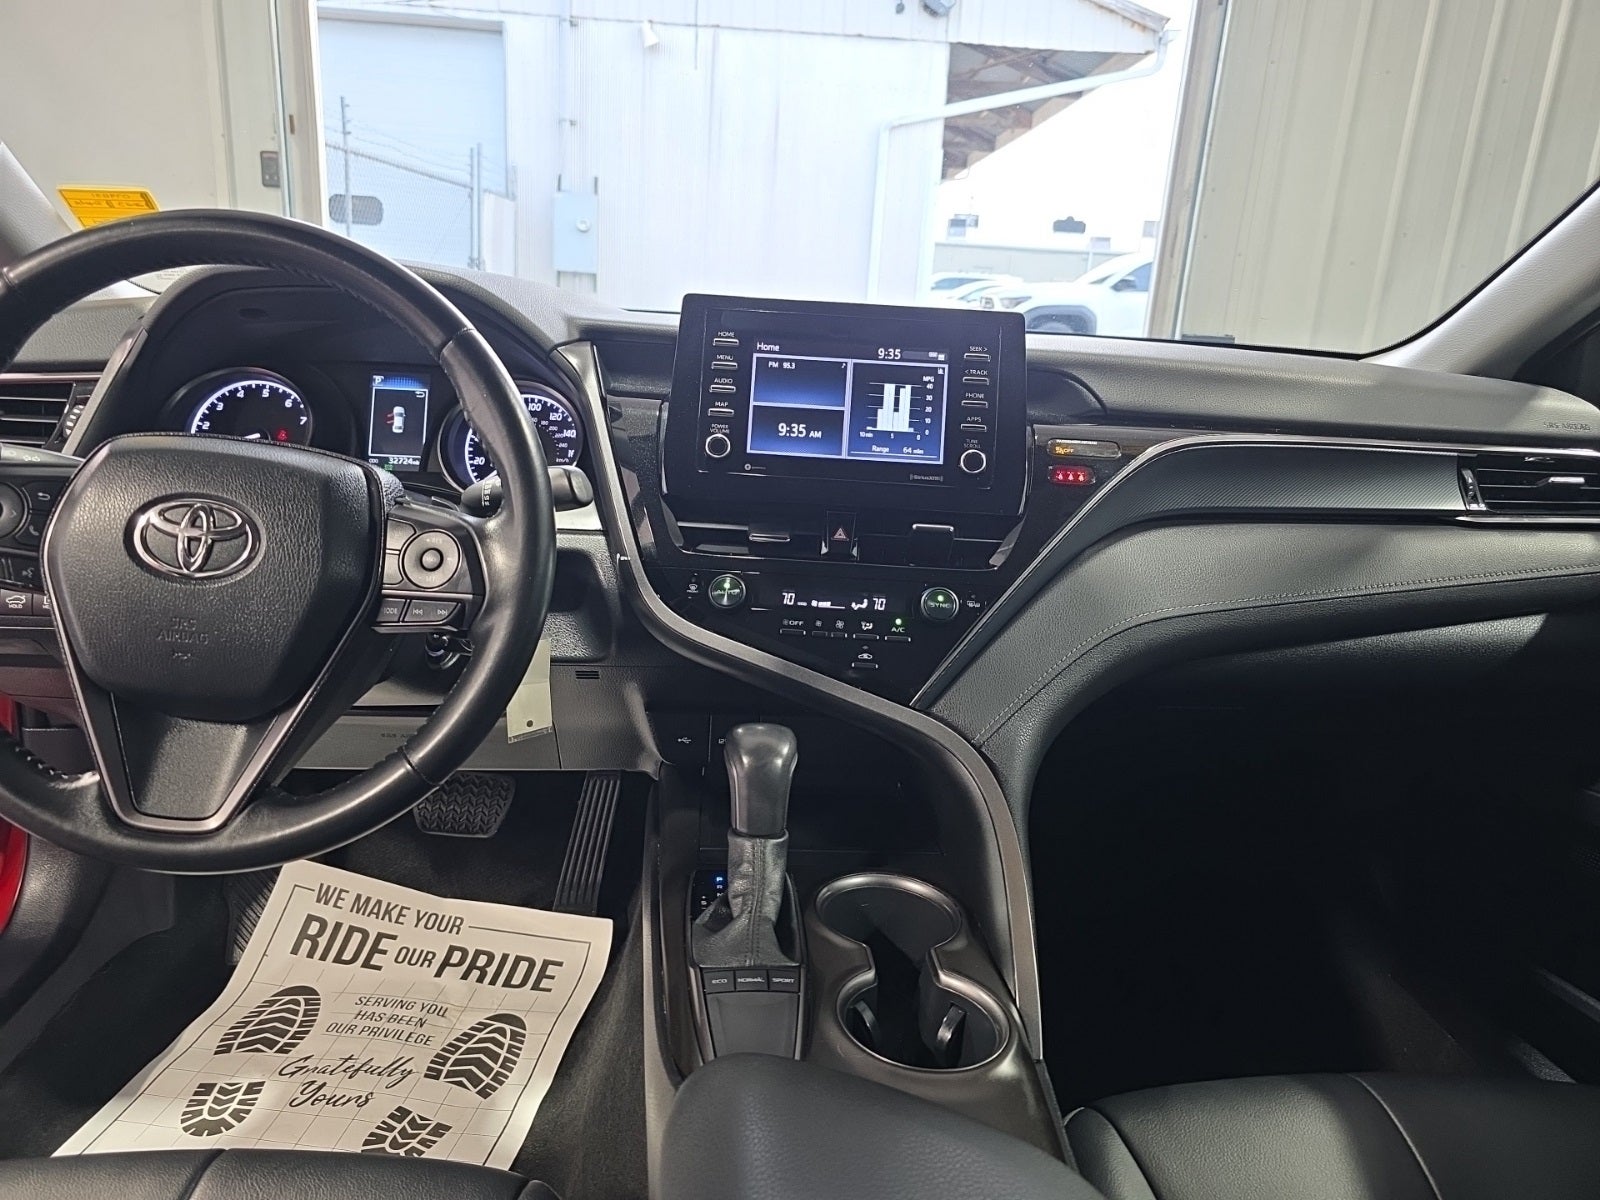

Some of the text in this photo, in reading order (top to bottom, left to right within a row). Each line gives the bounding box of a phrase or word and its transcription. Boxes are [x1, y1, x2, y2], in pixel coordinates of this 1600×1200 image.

[757, 342, 780, 351] Home
[878, 348, 901, 360] 9:35
[375, 377, 382, 385] P
[237, 390, 244, 398] 4
[262, 389, 270, 398] 5
[216, 402, 224, 411] 3
[284, 399, 293, 408] 6
[528, 403, 542, 412] 100
[299, 416, 308, 425] 7
[549, 412, 563, 421] 120
[201, 421, 210, 430] 2
[563, 429, 577, 438] 140
[778, 422, 822, 439] 9:35 AM
[871, 445, 889, 454] Range
[388, 457, 413, 465] 32724
[473, 456, 485, 466] 20
[782, 592, 796, 605] 70
[873, 597, 886, 610] 70
[315, 882, 466, 936] WE MAKE YOUR
[289, 912, 565, 993] RIDE OUR PRIDE
[354, 995, 449, 1018] SERVING YOU
[353, 1009, 428, 1029] HAS BEEN
[325, 1022, 436, 1047] OUR PRIVILEGE
[278, 1054, 420, 1089] Gratefully
[288, 1080, 377, 1108] Yours
